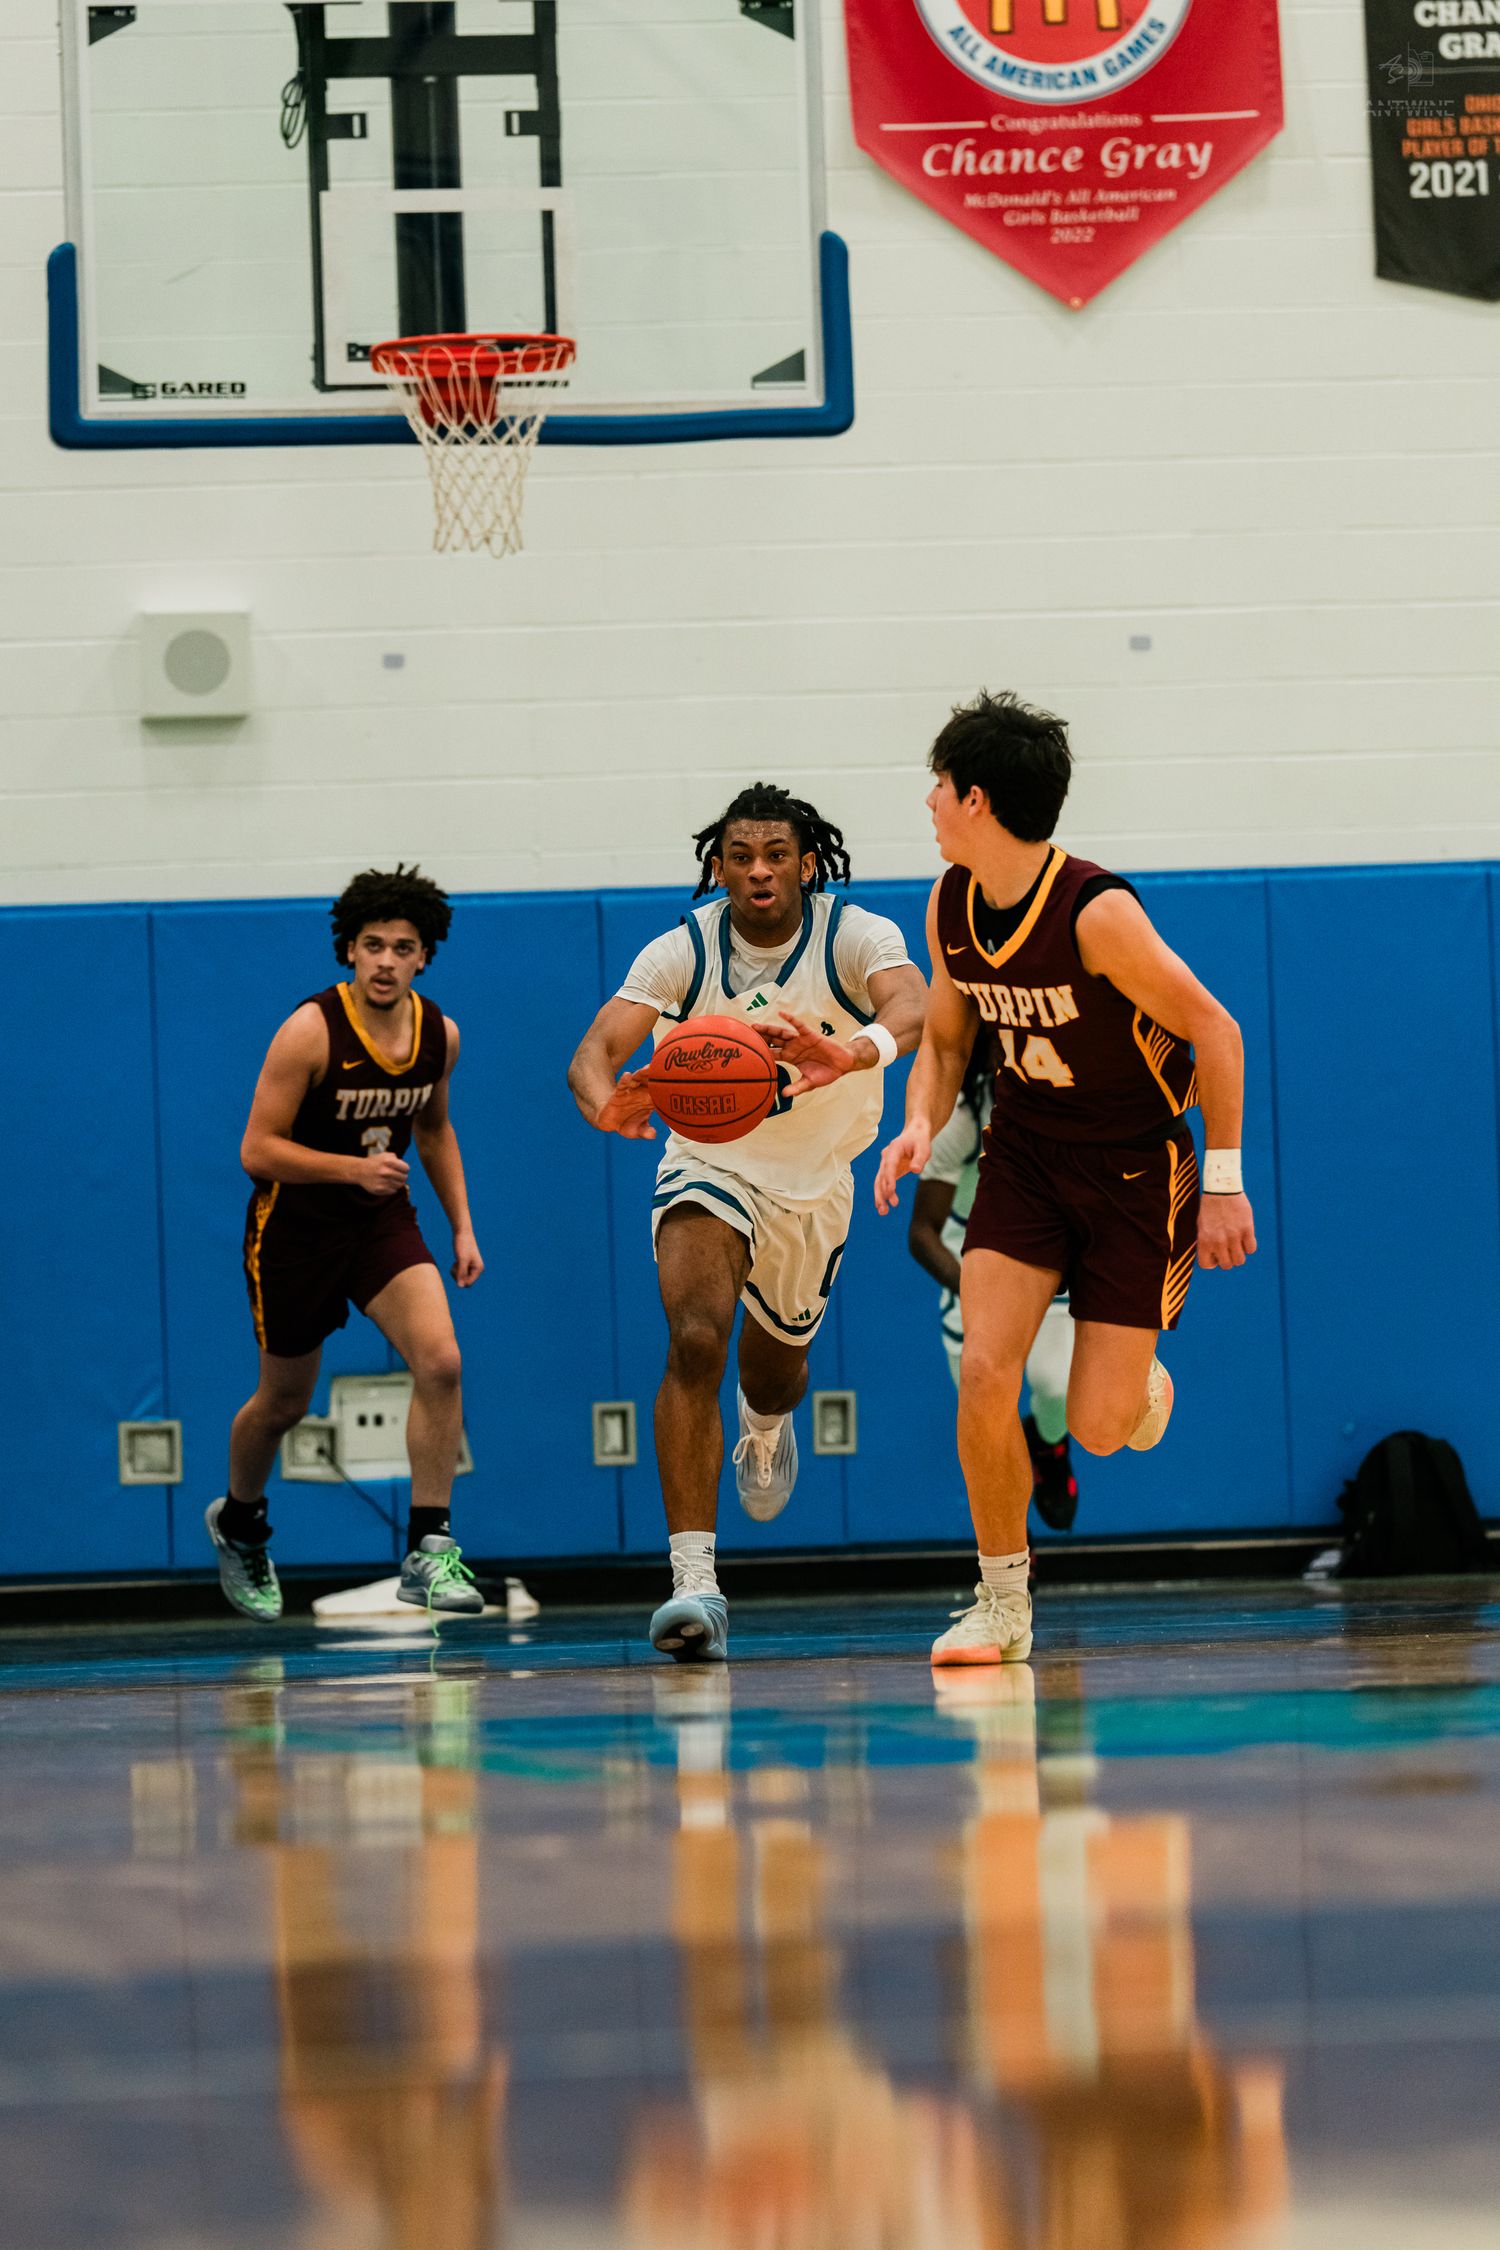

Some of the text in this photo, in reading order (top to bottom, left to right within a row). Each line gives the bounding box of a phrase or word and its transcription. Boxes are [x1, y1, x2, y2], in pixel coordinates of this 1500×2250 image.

[948, 17, 1167, 91] ALL AMERICAN GAMES
[990, 113, 1142, 134] Congratulations
[922, 136, 1213, 180] Chance Gray
[1402, 138, 1465, 159] PLAYER
[1467, 136, 1489, 157] OF
[1408, 159, 1490, 199] 2021
[1066, 188, 1092, 206] All
[1094, 187, 1178, 203] American
[1002, 205, 1140, 226] Girls Basketball
[161, 382, 246, 395] GARED
[664, 1041, 743, 1072] Rawlings
[998, 1028, 1076, 1088] 14
[670, 1093, 736, 1116] OHSAA
